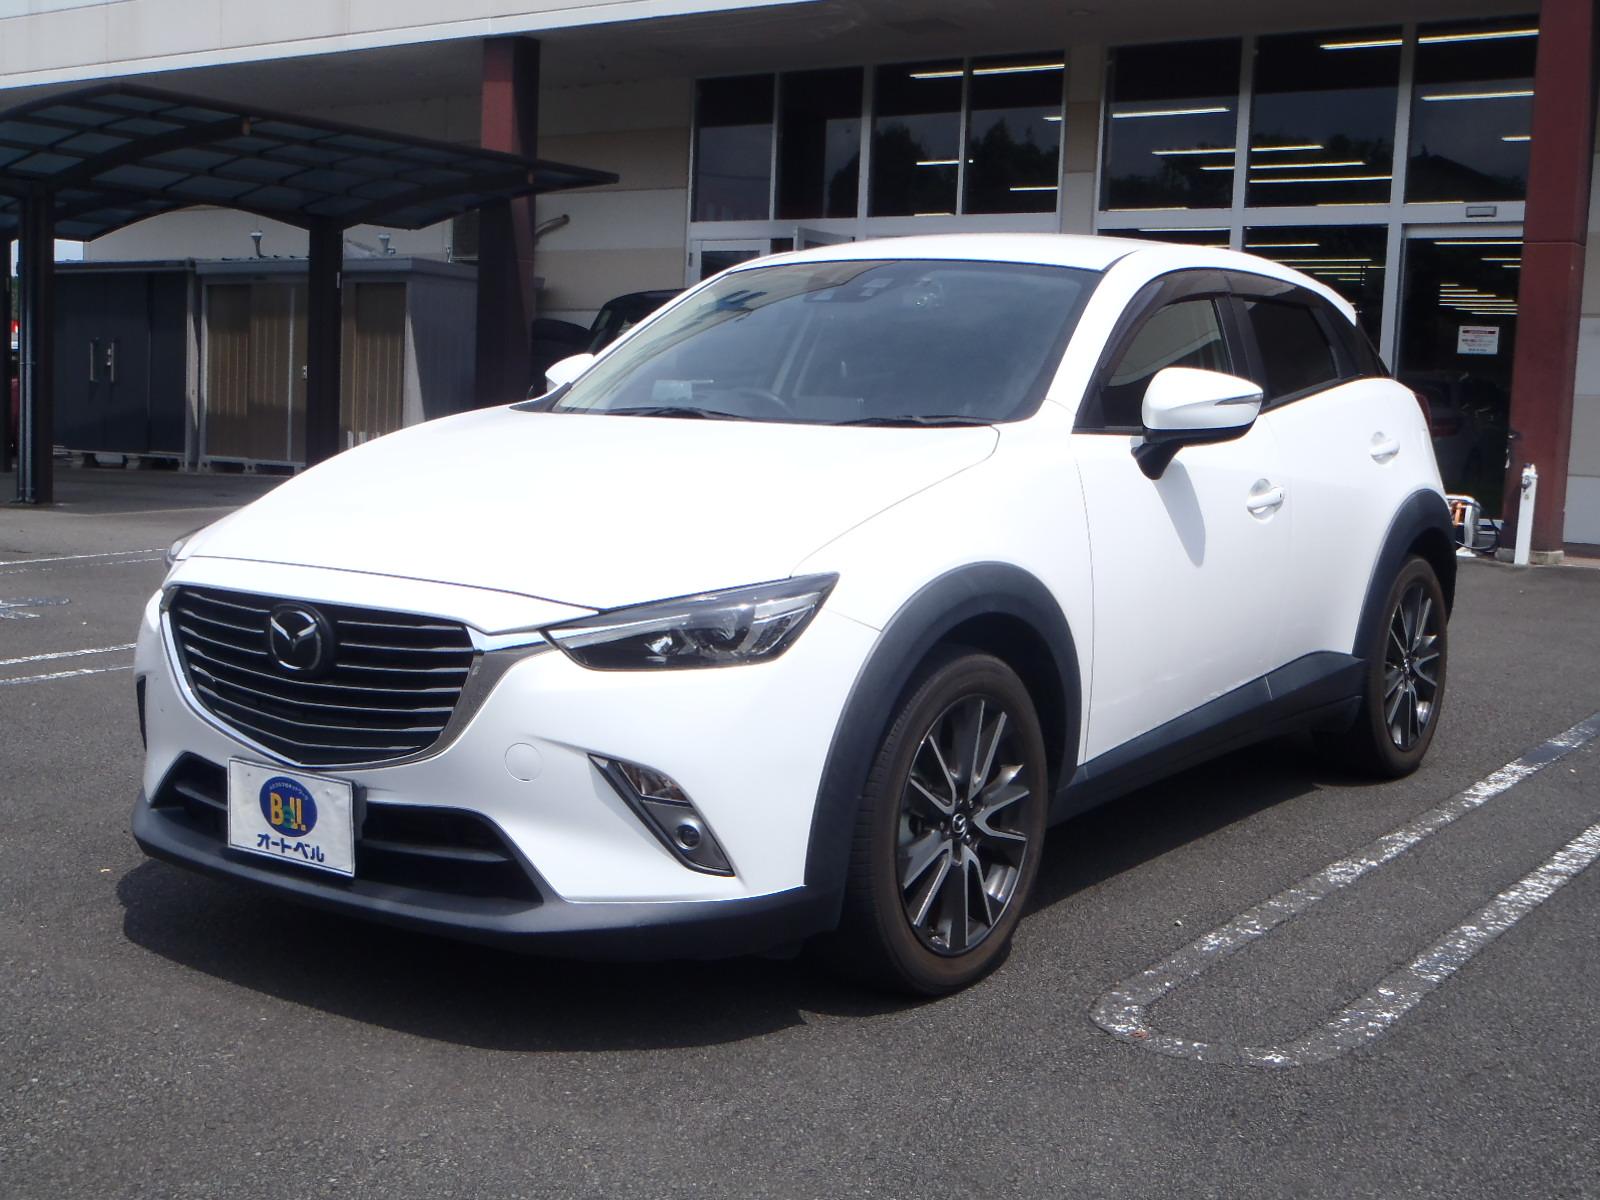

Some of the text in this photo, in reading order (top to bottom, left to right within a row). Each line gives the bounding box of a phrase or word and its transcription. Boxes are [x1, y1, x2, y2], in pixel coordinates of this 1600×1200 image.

[257, 833, 324, 862] オートベル
